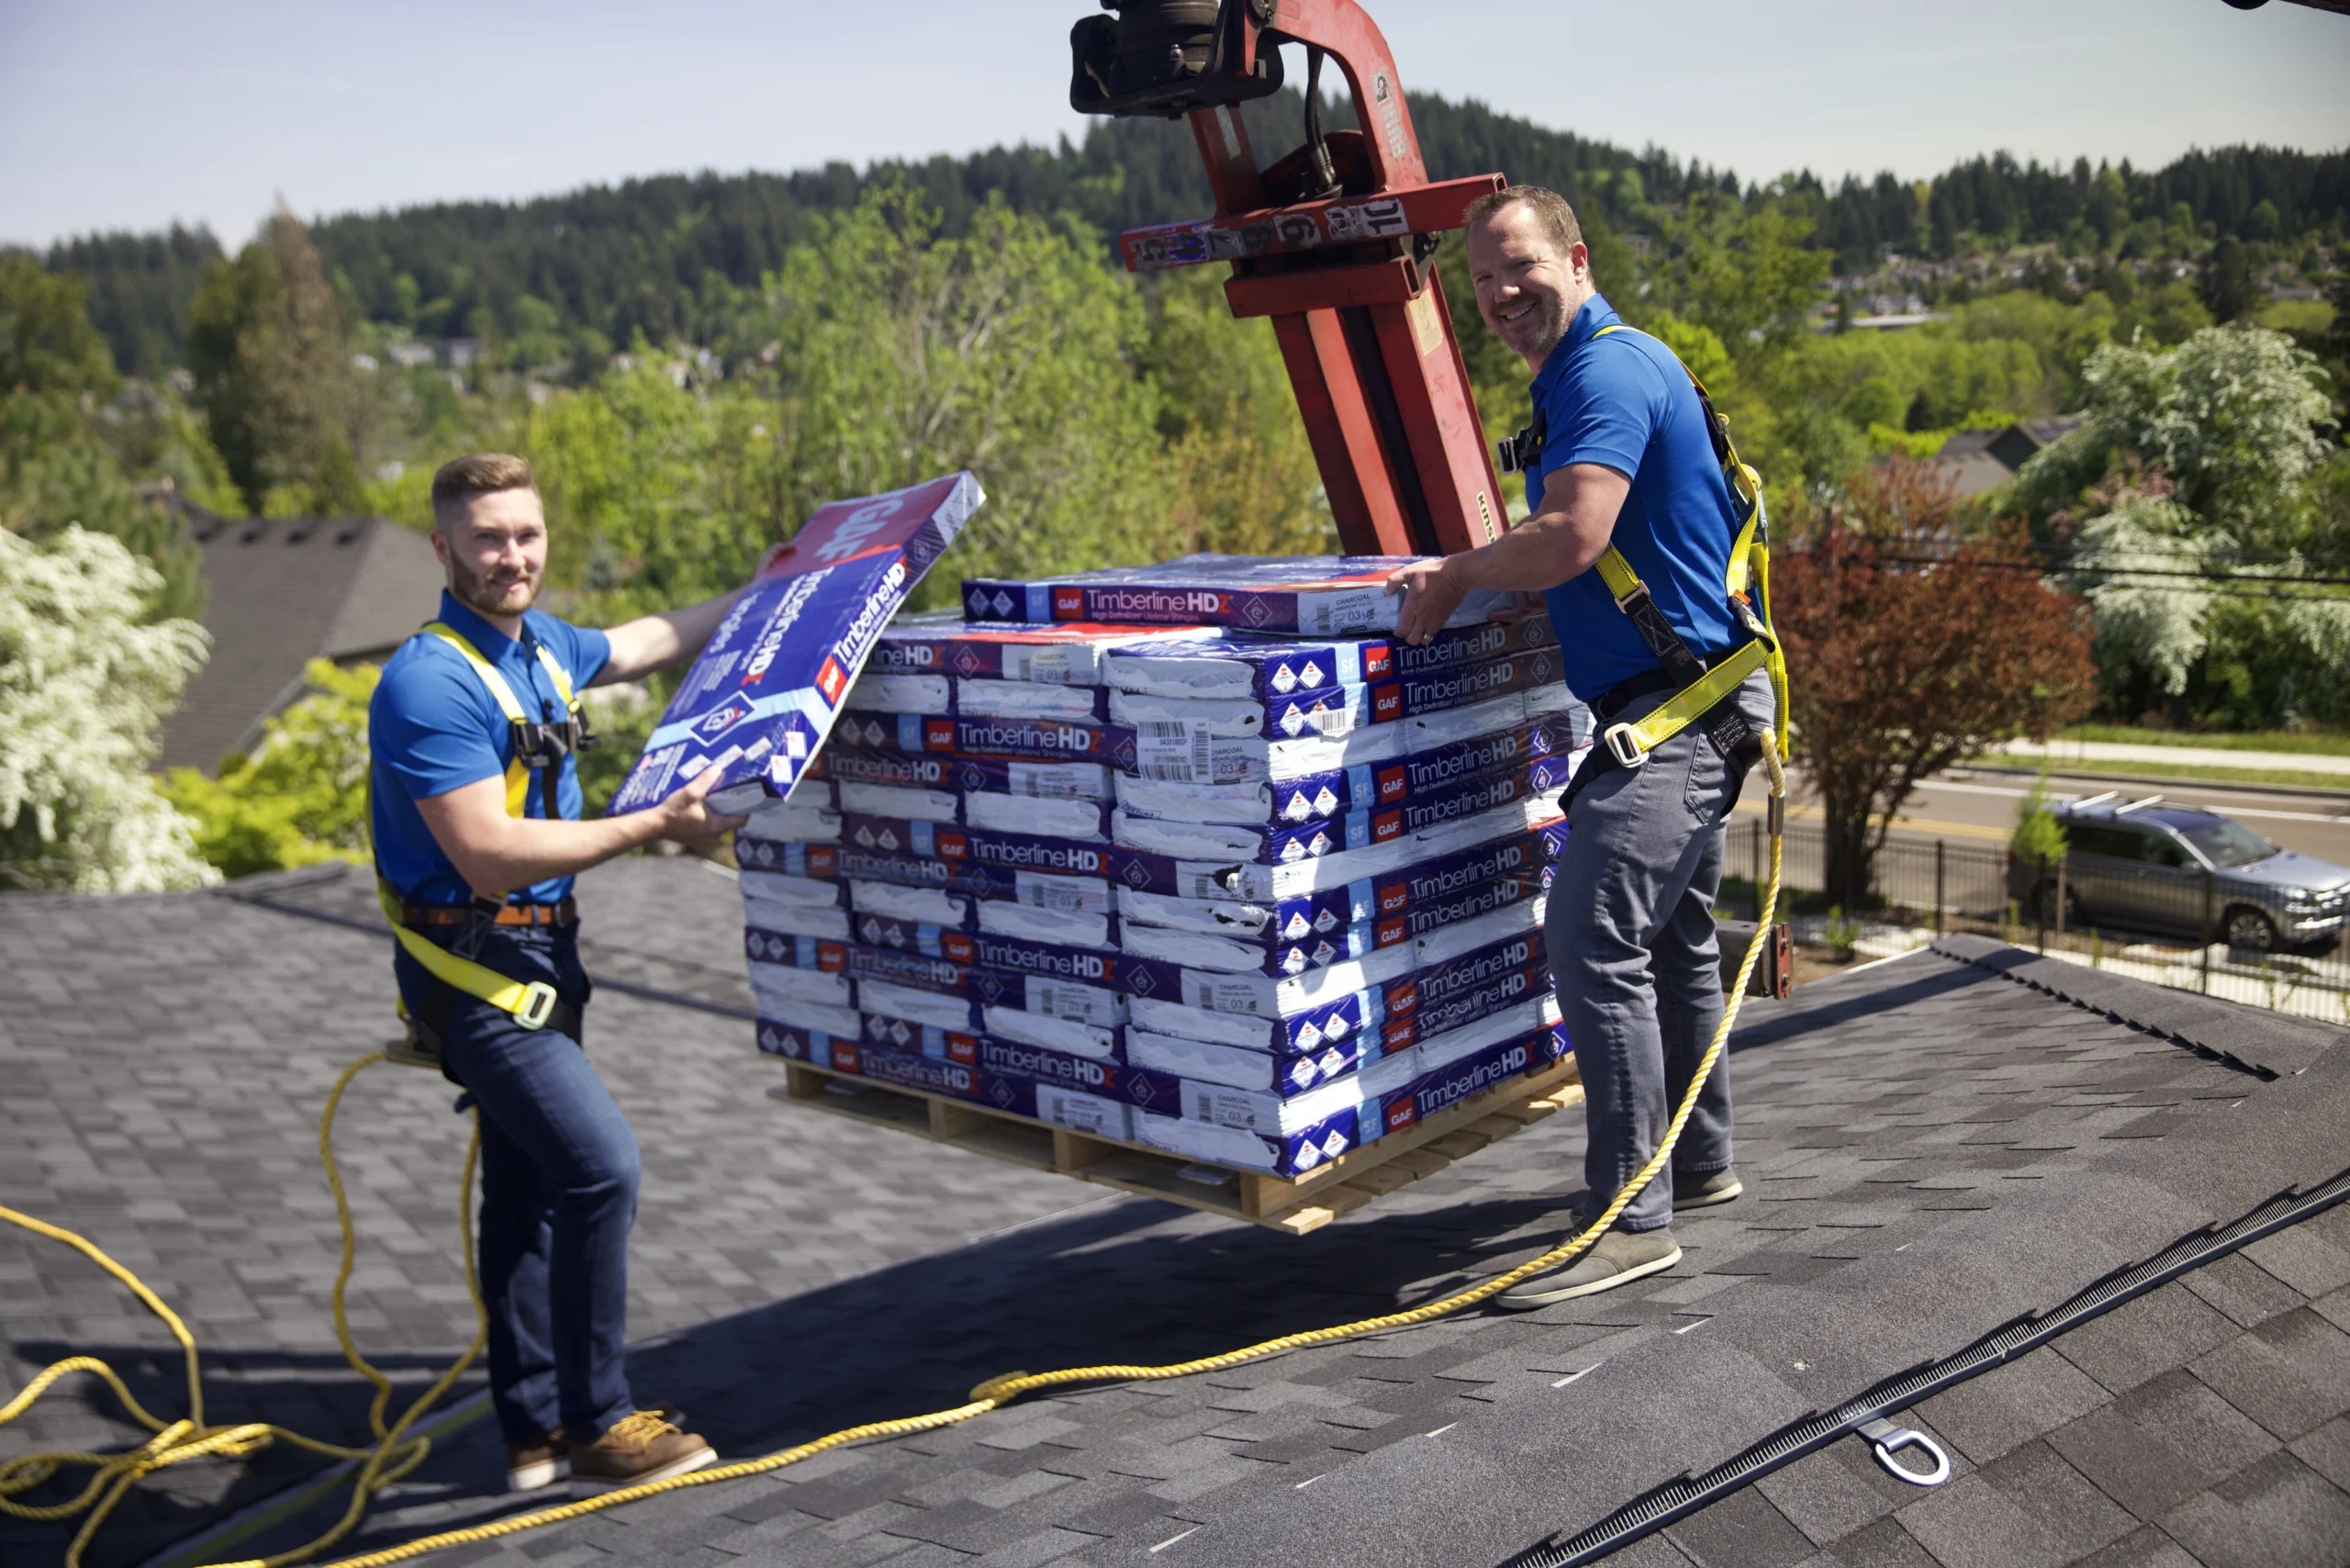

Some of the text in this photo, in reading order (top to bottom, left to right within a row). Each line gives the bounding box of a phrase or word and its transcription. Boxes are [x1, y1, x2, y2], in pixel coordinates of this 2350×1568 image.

[815, 498, 904, 563] GAF
[1058, 599, 1080, 610] GAF
[1337, 593, 1371, 605] CHARCOAL
[1348, 610, 1361, 622] 03
[1340, 657, 1355, 674] SF
[1368, 659, 1390, 672] GAF
[823, 665, 839, 693] GAF
[1378, 696, 1399, 711] GAF
[930, 732, 952, 745] GAF
[1220, 763, 1234, 774] 03
[1355, 782, 1369, 799] SF
[1382, 778, 1404, 794] GAF
[1350, 825, 1364, 841] SF
[1378, 821, 1400, 835] GAF
[942, 844, 964, 856] GAF
[1383, 894, 1406, 910] GAF
[1381, 926, 1403, 943] GAF
[1230, 999, 1243, 1010] 03
[1392, 994, 1416, 1012] GAF
[1389, 1027, 1411, 1044] GAF
[1391, 1107, 1413, 1126] GAF
[1363, 1117, 1377, 1135] SF
